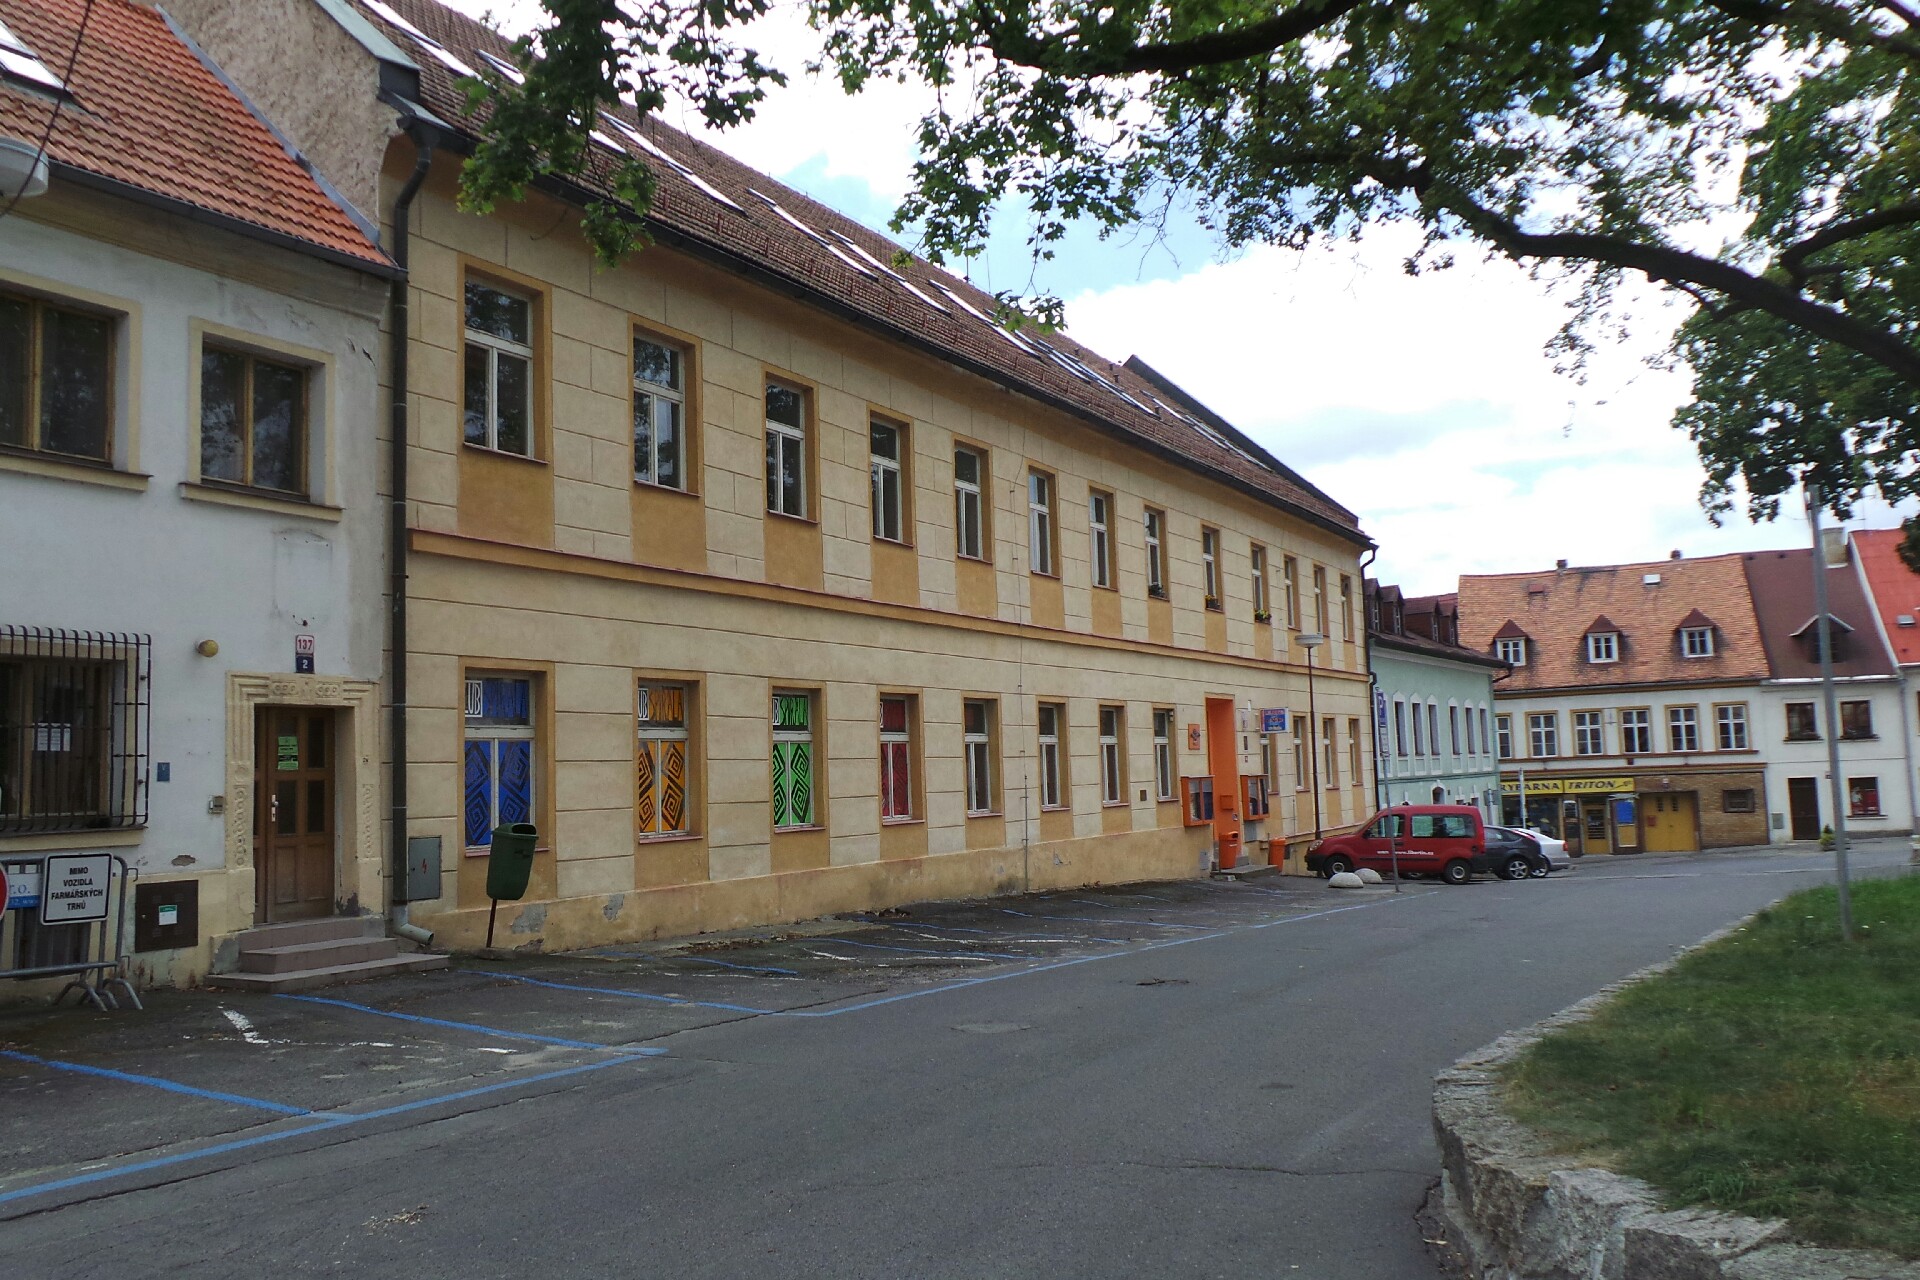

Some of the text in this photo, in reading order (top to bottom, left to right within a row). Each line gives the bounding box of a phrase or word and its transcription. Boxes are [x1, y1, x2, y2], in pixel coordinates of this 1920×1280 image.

[297, 639, 313, 650] 137
[302, 659, 308, 669] 2
[1568, 780, 1615, 789] TRITON
[69, 867, 89, 875] MIMO
[63, 878, 93, 887] VOZIDLA
[51, 888, 104, 900] FARMÁŘSKÝCH
[66, 900, 86, 911] TRHŮ
